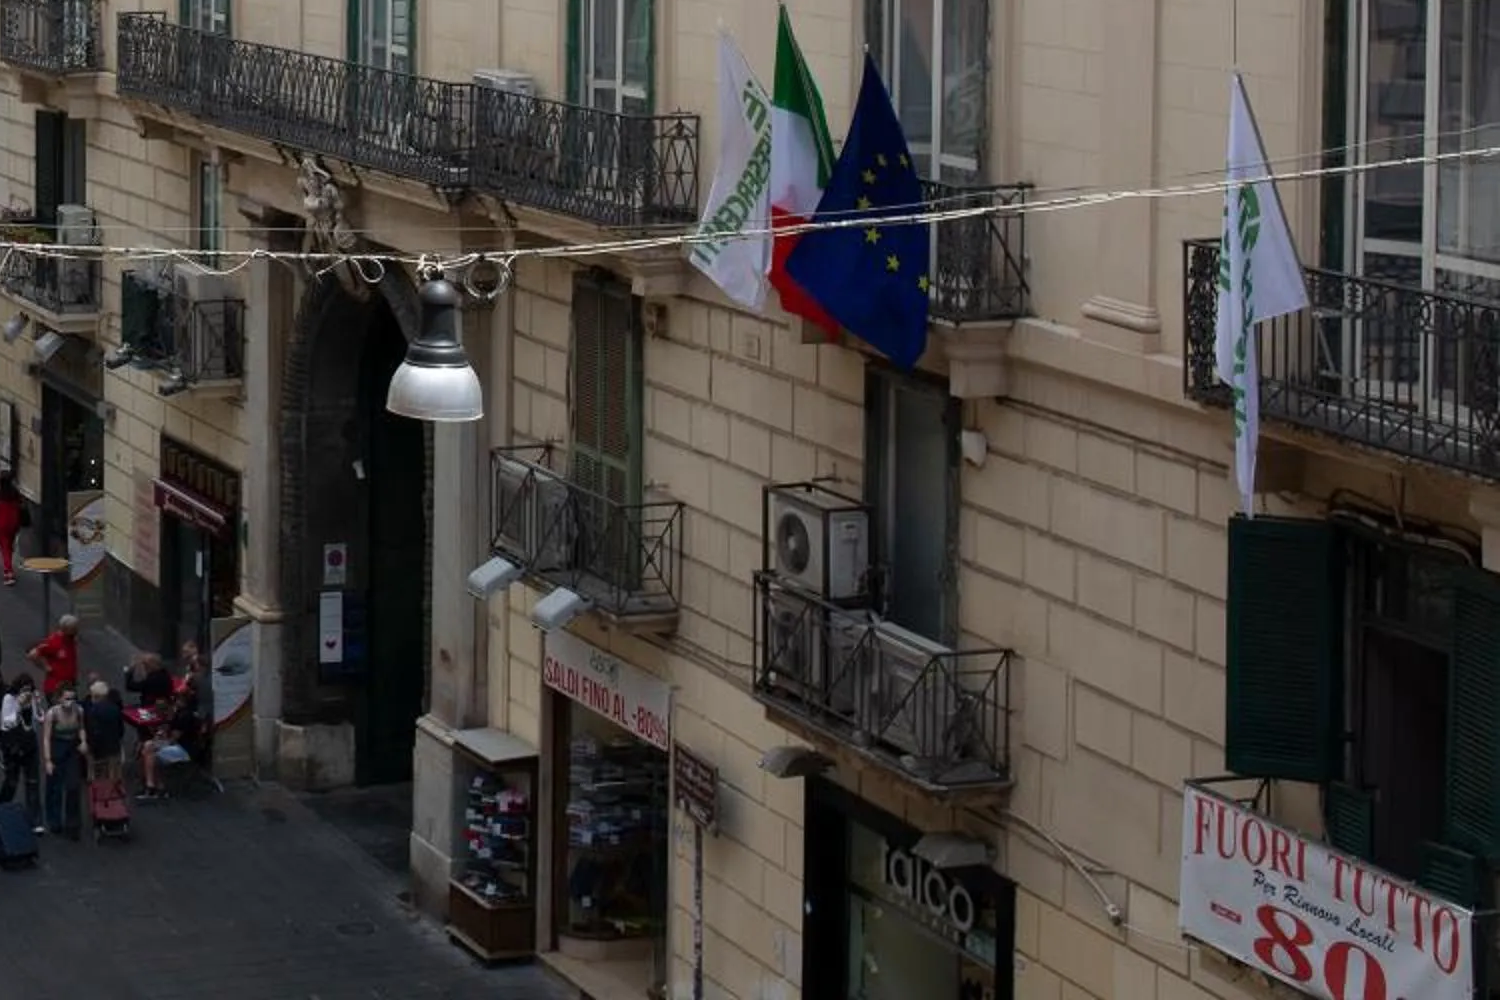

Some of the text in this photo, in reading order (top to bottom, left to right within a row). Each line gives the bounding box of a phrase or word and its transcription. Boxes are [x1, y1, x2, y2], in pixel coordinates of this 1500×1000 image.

[545, 657, 580, 698] SALDI
[582, 677, 610, 714] FINO
[613, 693, 629, 727] AL
[1193, 795, 1460, 974] FUORI TUTTO
[1252, 869, 1396, 953] Per Rinnovo Locali
